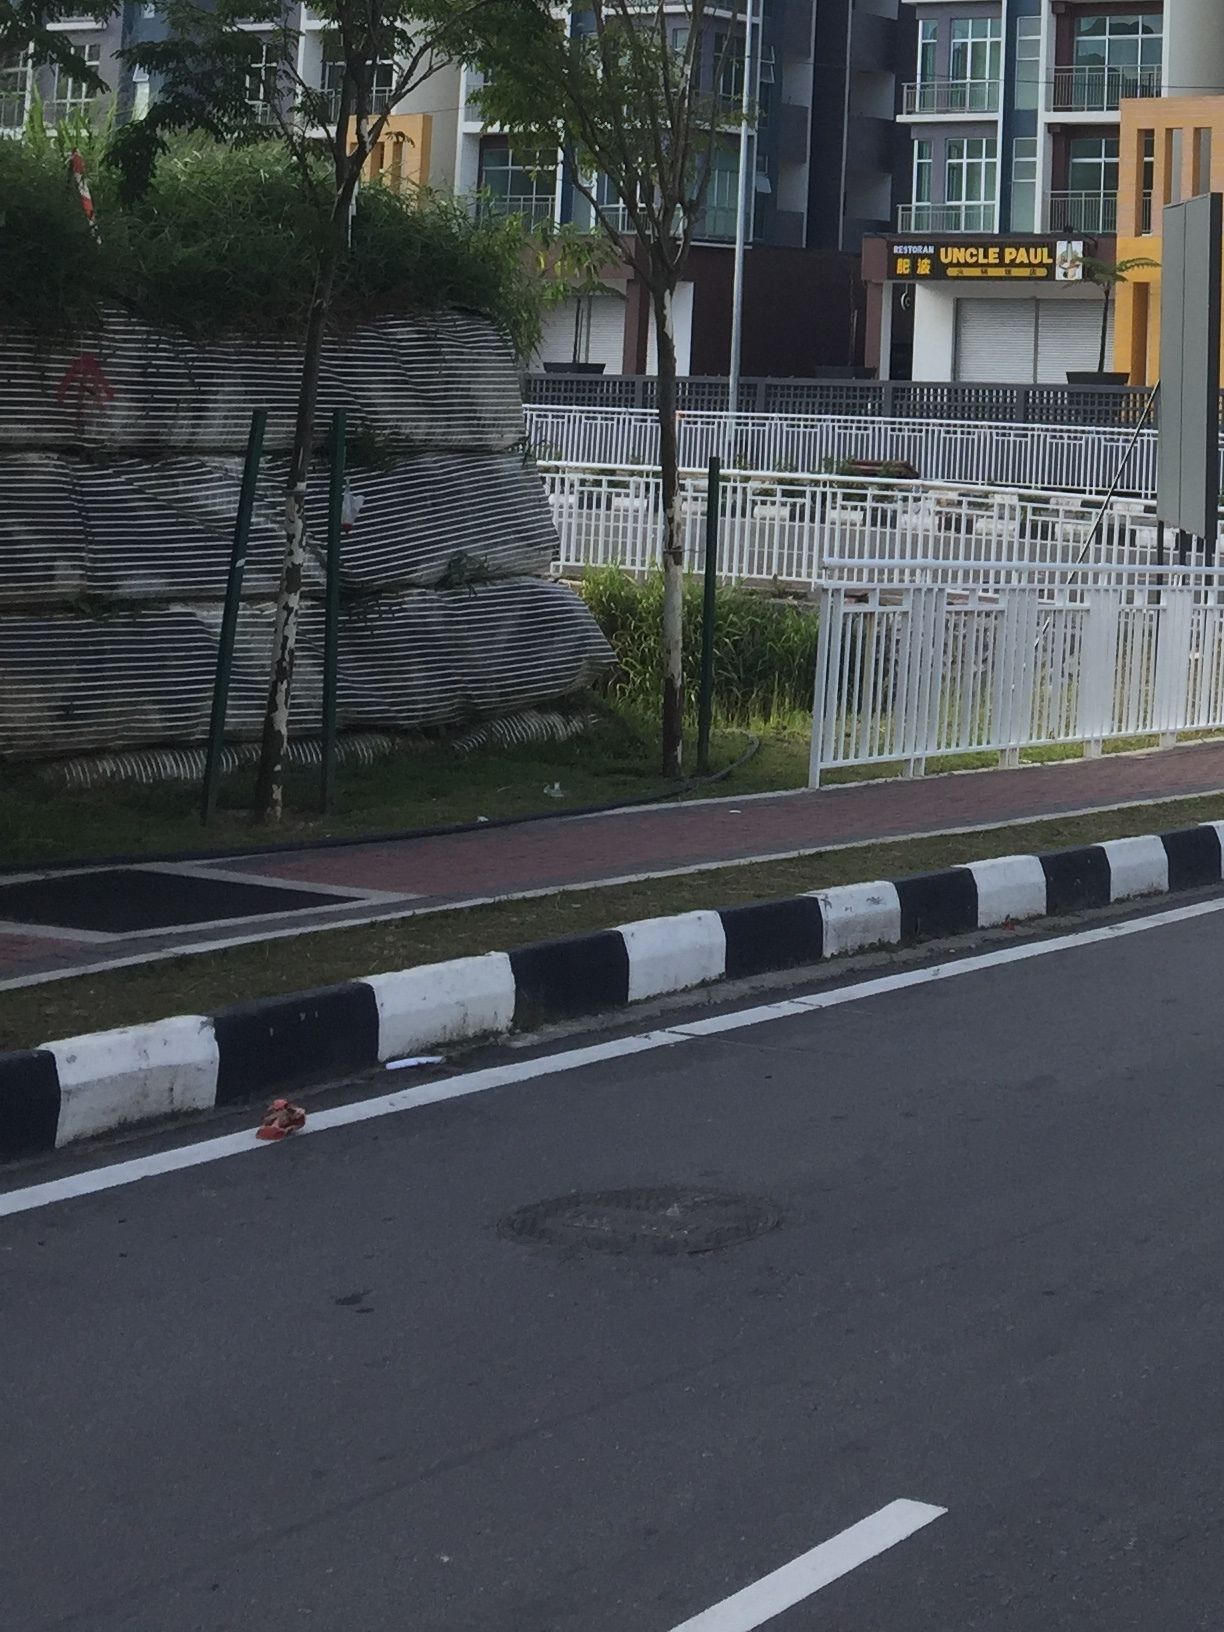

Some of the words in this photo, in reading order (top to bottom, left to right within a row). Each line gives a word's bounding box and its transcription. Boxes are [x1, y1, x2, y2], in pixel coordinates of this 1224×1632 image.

[893, 245, 935, 254] RESTORAN
[939, 247, 1000, 264] UNCLE
[1004, 247, 1053, 264] PAUL
